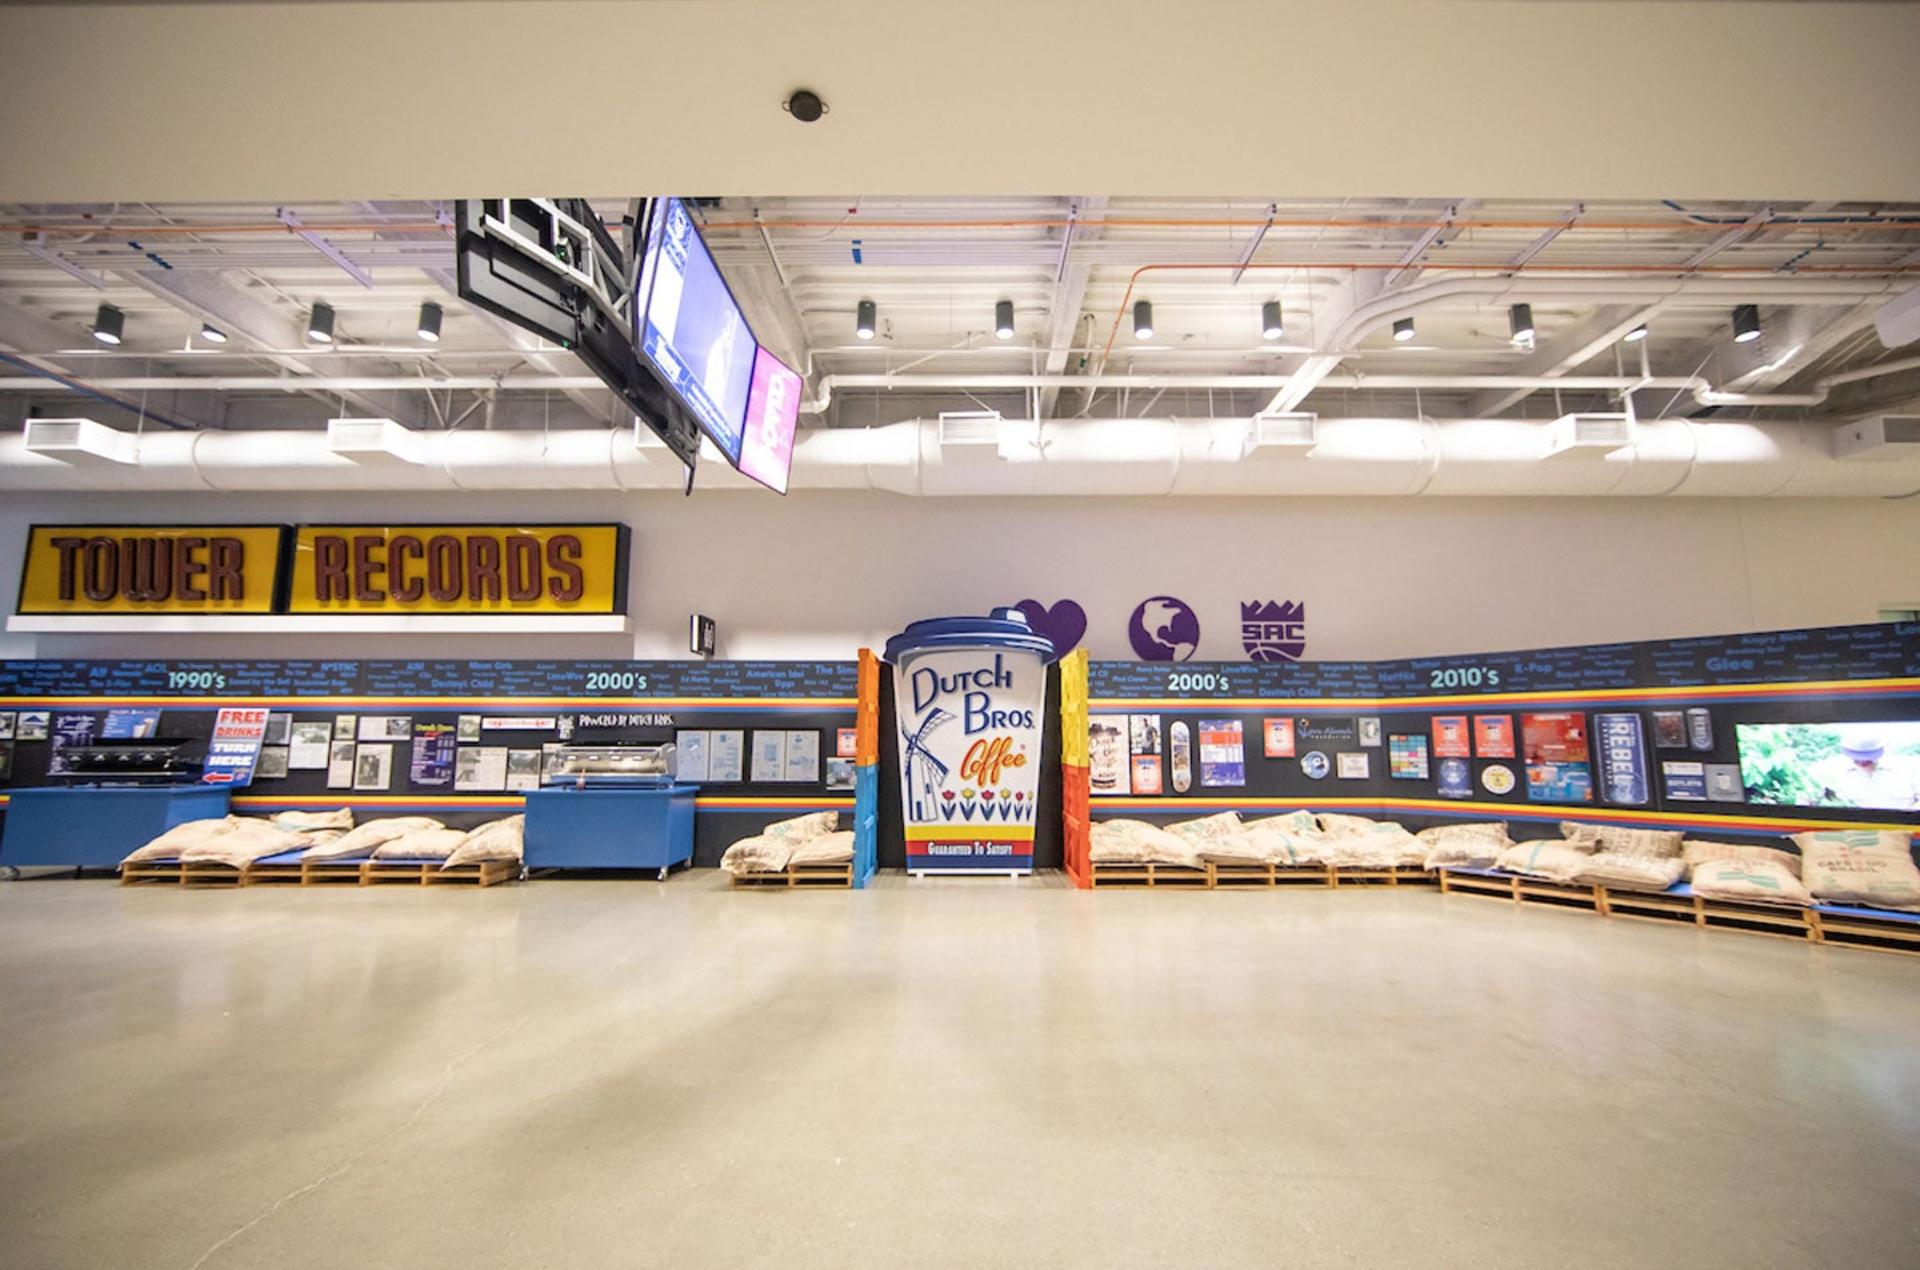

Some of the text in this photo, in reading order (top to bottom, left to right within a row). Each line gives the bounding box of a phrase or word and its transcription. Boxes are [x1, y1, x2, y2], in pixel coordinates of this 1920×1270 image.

[51, 535, 585, 602] TOWER RECORDS
[1242, 624, 1305, 640] SAC
[1706, 657, 1755, 672] Glee
[168, 672, 226, 689] 1990's
[585, 672, 648, 690] 2000's
[1168, 673, 1229, 691] 2000's
[1430, 667, 1500, 688] 2010's
[221, 711, 265, 724] FREE
[216, 727, 263, 737] DRINKS
[213, 743, 257, 753] TURN
[1608, 722, 1635, 785] REBEL
[208, 755, 253, 766] HERE
[960, 735, 1028, 788] Coffee
